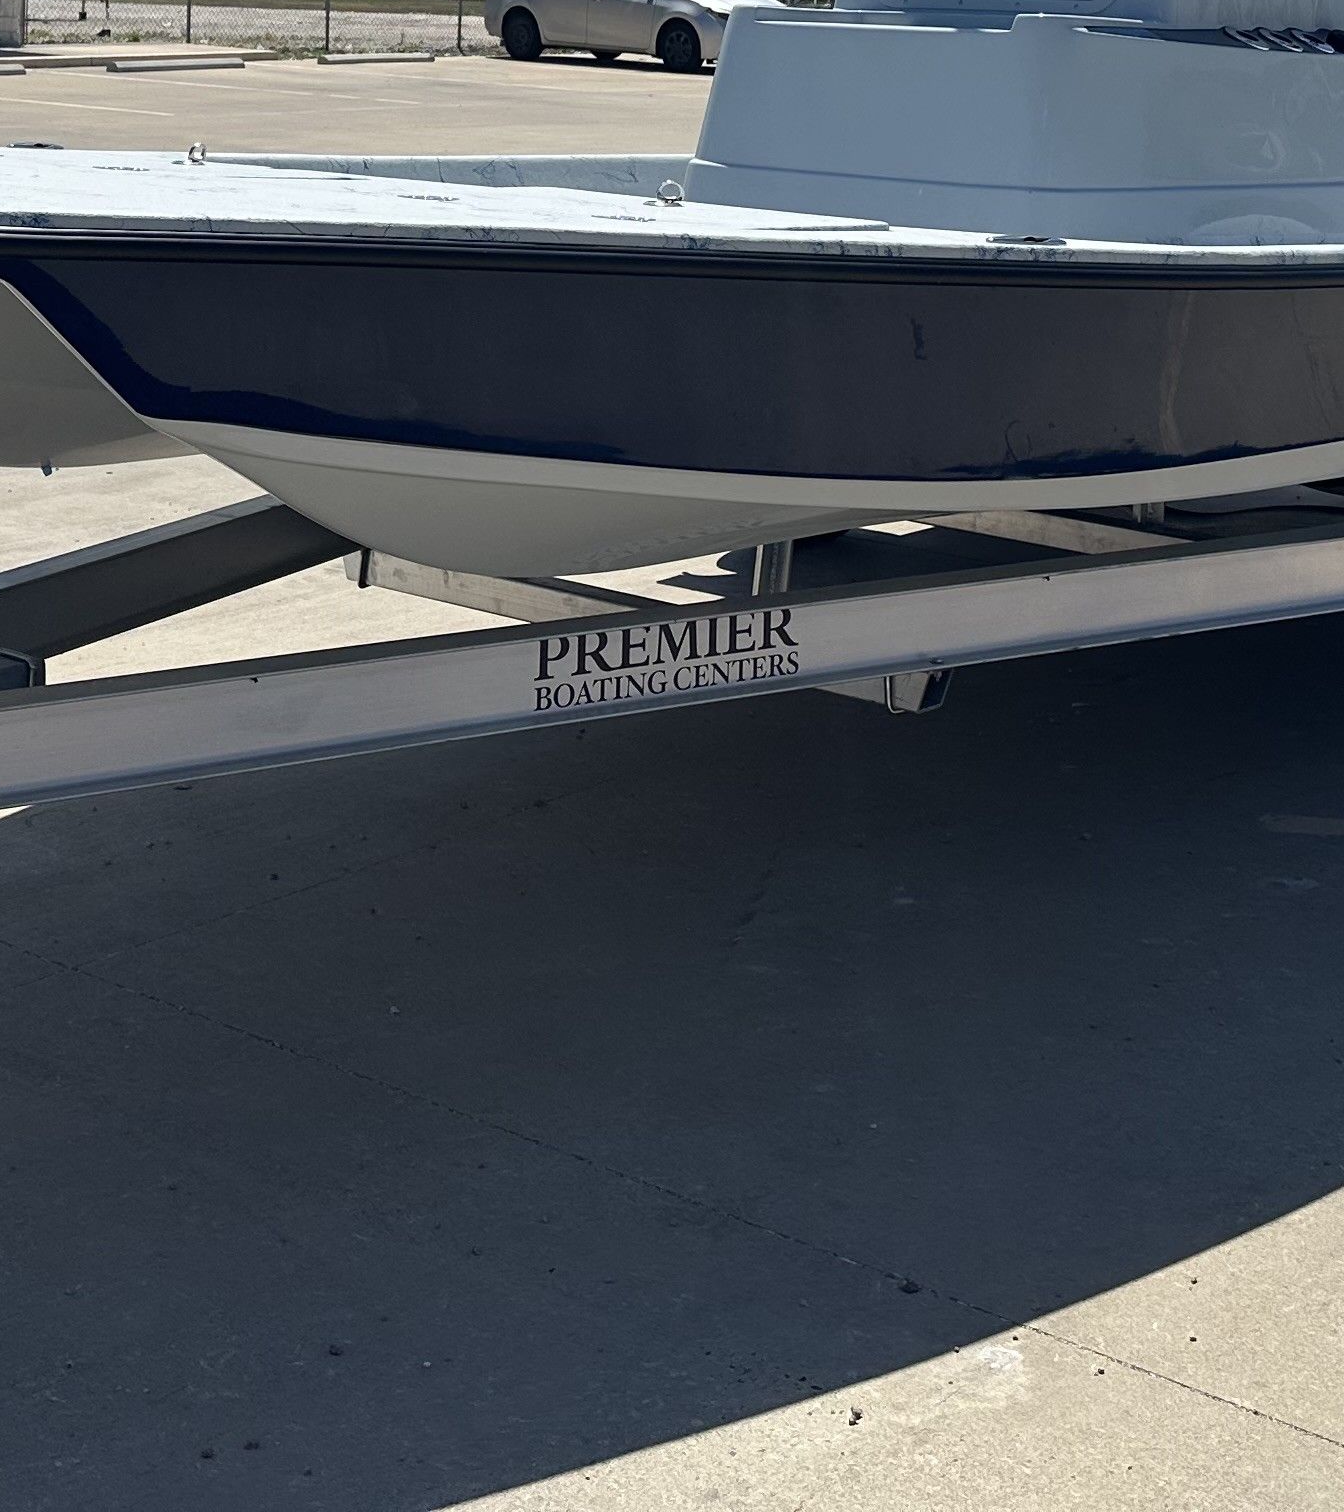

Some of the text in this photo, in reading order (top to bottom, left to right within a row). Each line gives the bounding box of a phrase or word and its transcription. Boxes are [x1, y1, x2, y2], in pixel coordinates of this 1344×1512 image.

[534, 608, 799, 681] PREMIER
[533, 651, 800, 711] BOATING CENTERS
